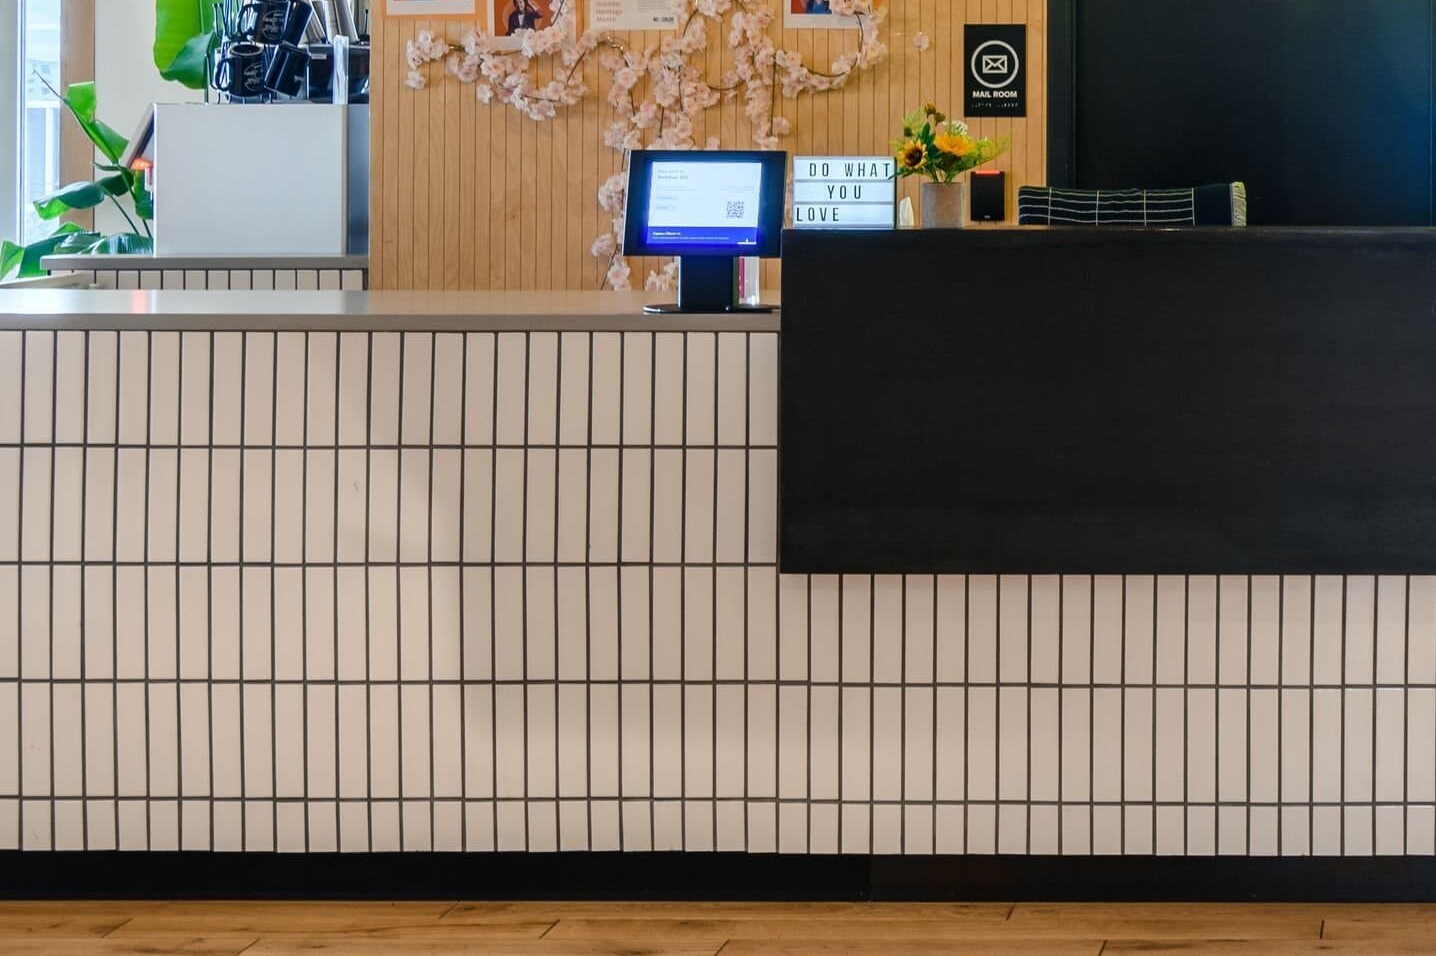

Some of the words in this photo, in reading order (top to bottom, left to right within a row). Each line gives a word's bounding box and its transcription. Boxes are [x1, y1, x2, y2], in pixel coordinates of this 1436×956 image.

[972, 90, 991, 98] MAIL
[993, 90, 1018, 98] ROOM
[809, 163, 829, 177] DO
[844, 163, 891, 177] WHAT
[827, 185, 862, 199] YOU
[796, 207, 840, 222] LOVE
